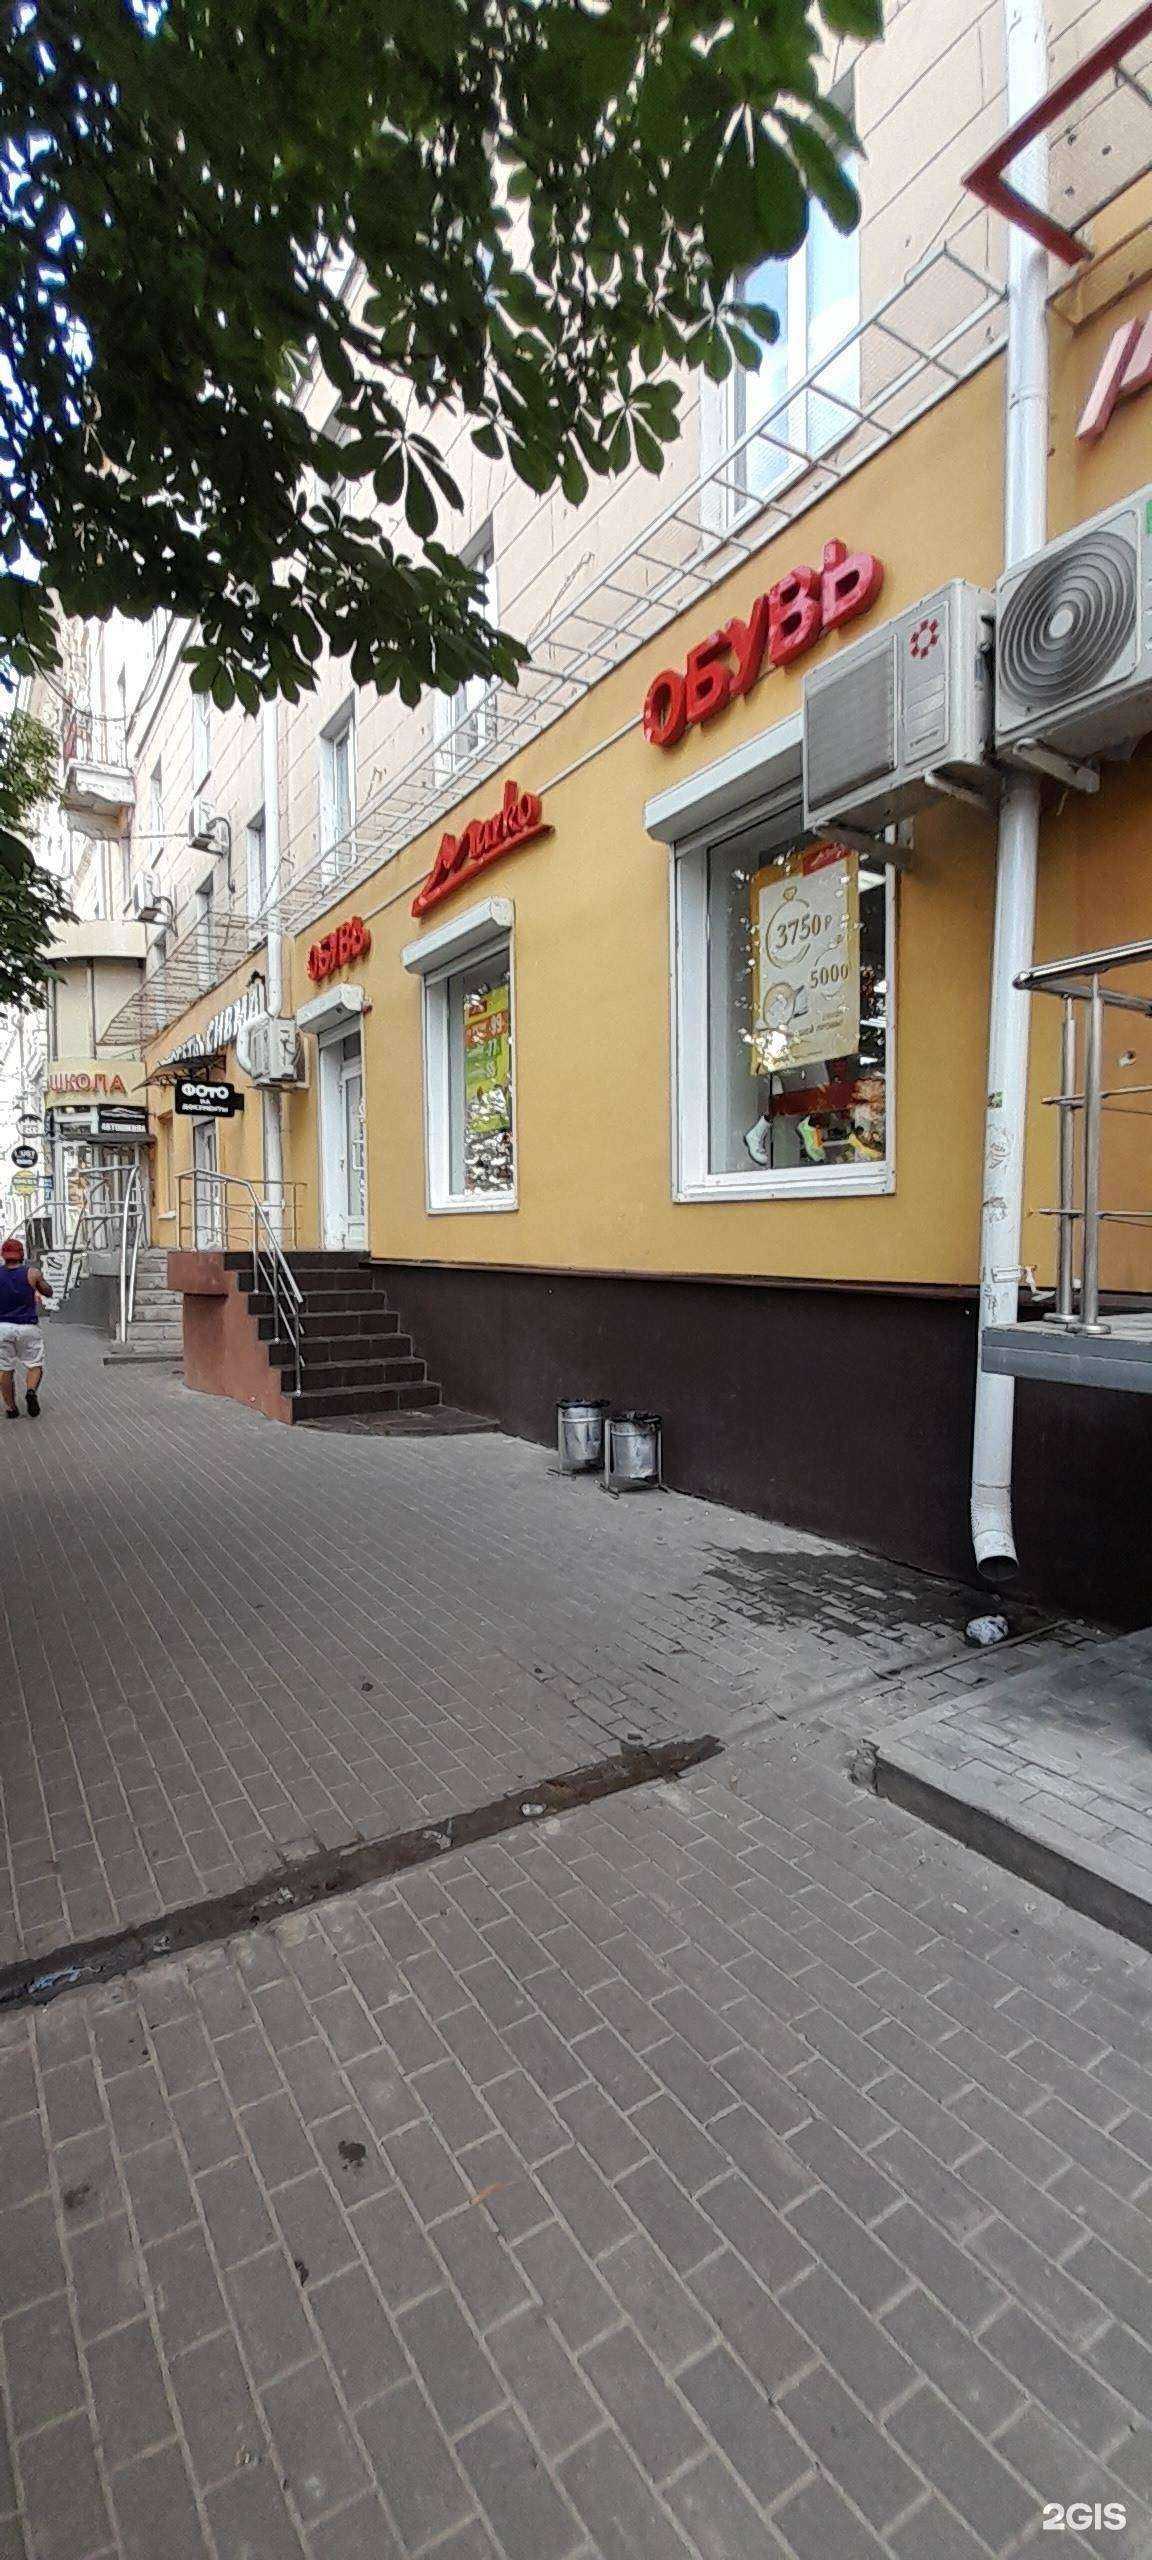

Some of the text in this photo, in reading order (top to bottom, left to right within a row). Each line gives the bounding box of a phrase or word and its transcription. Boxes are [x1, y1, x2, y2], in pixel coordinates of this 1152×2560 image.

[643, 537, 884, 747] ОБУВЬ
[308, 916, 371, 981] ОБУВЬ
[48, 1073, 127, 1095] ШКОЛА
[181, 1083, 229, 1099] ФОТО
